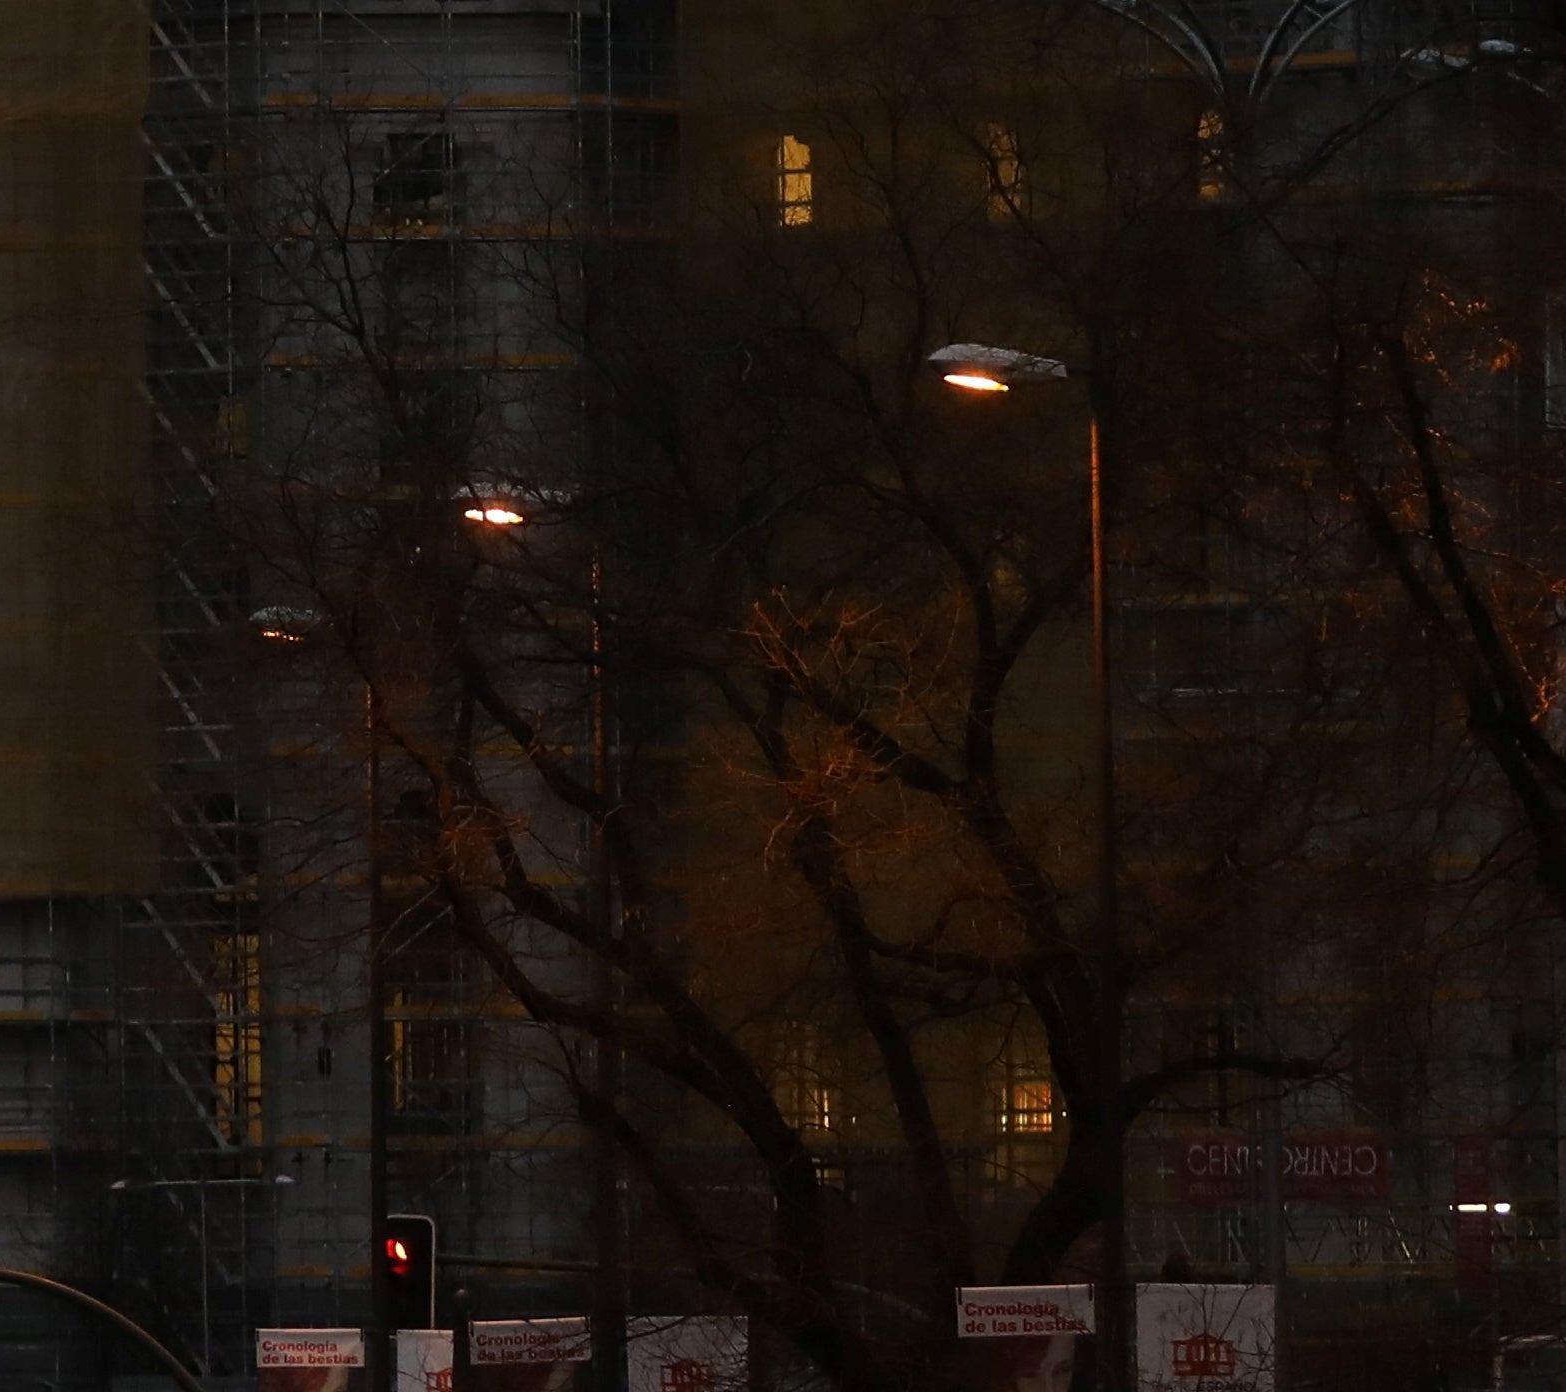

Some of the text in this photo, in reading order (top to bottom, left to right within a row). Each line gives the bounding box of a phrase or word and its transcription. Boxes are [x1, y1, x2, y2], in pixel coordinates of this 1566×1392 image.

[964, 1301, 1060, 1319] Cronología
[965, 1316, 1088, 1334] de las bestias
[262, 1339, 338, 1354] Cronología
[262, 1353, 359, 1365] de las bestias
